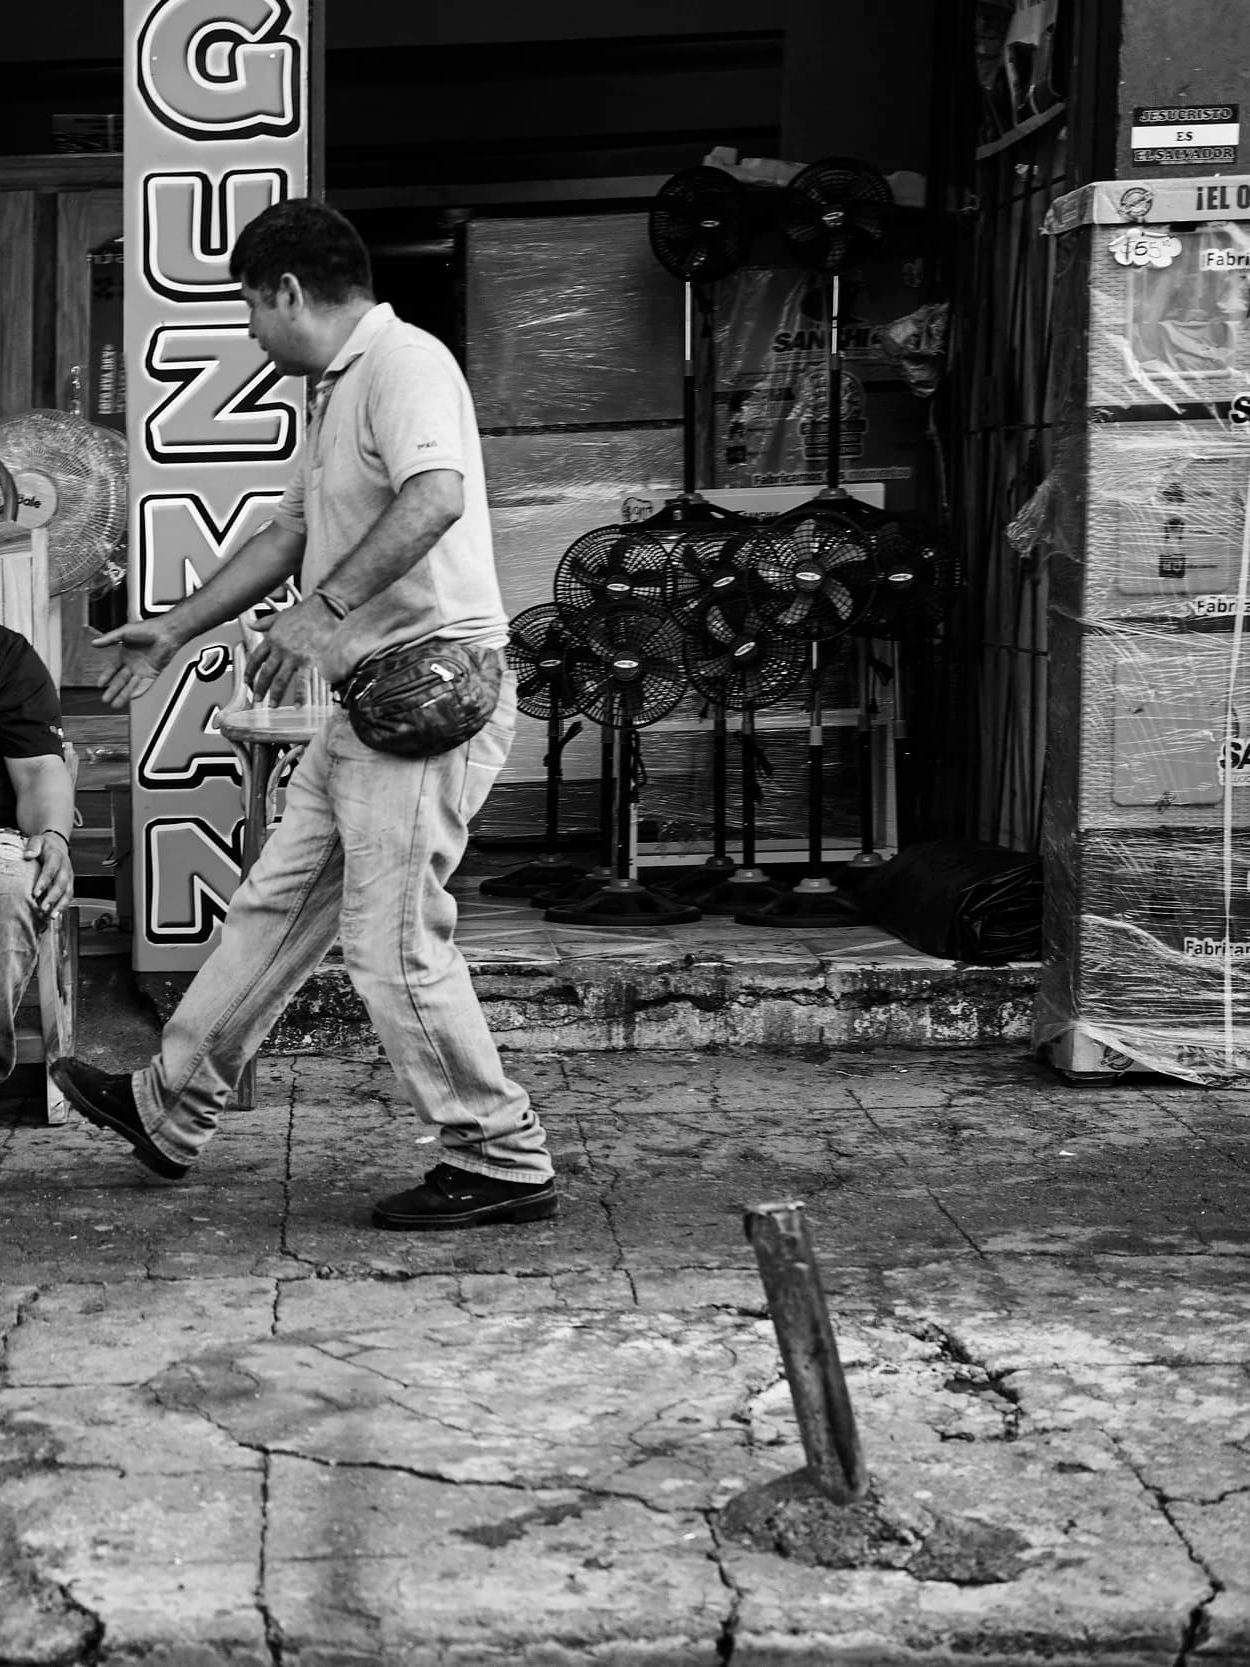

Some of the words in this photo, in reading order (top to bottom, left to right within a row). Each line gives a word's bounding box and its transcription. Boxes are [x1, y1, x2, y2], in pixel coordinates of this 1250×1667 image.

[1139, 107, 1233, 122] JESUCRISTO
[1176, 131, 1193, 142] ES
[1134, 149, 1152, 162] EL
[1155, 147, 1235, 161] SALVADOR
